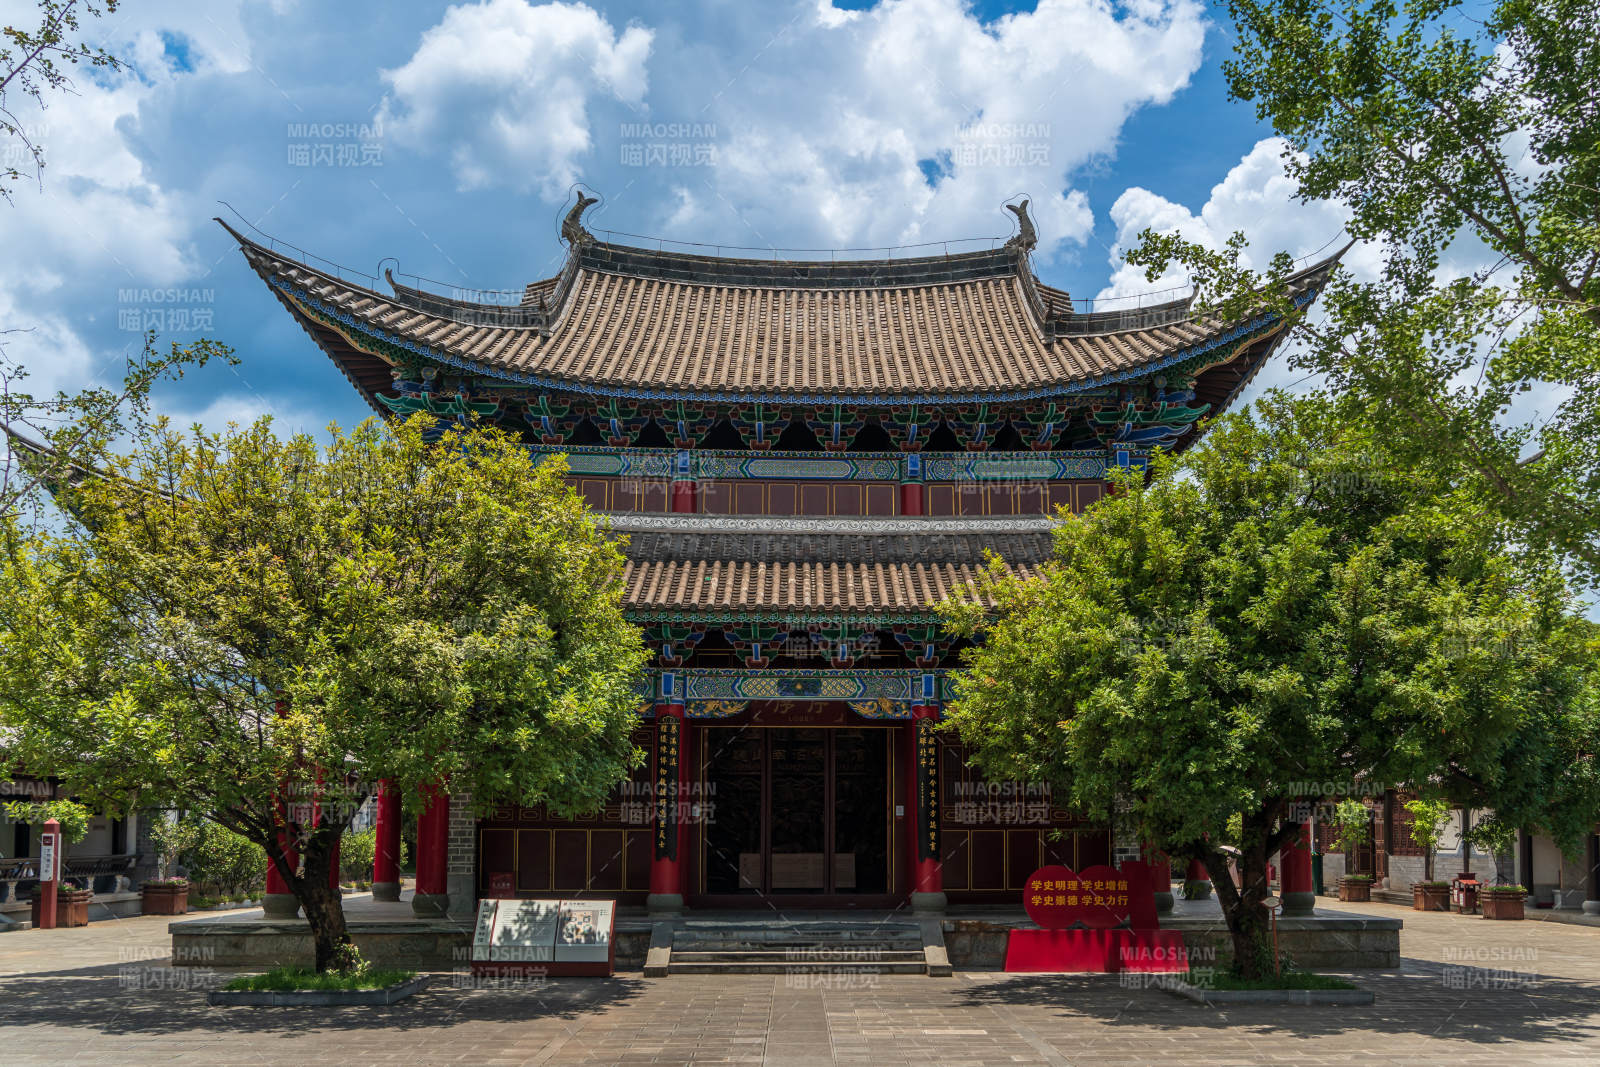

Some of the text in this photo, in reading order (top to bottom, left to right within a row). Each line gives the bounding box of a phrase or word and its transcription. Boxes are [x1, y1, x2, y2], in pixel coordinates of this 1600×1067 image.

[1031, 880, 1129, 891] 学史明理 学史增信
[1031, 895, 1129, 906] 学史崇德 学史力行
